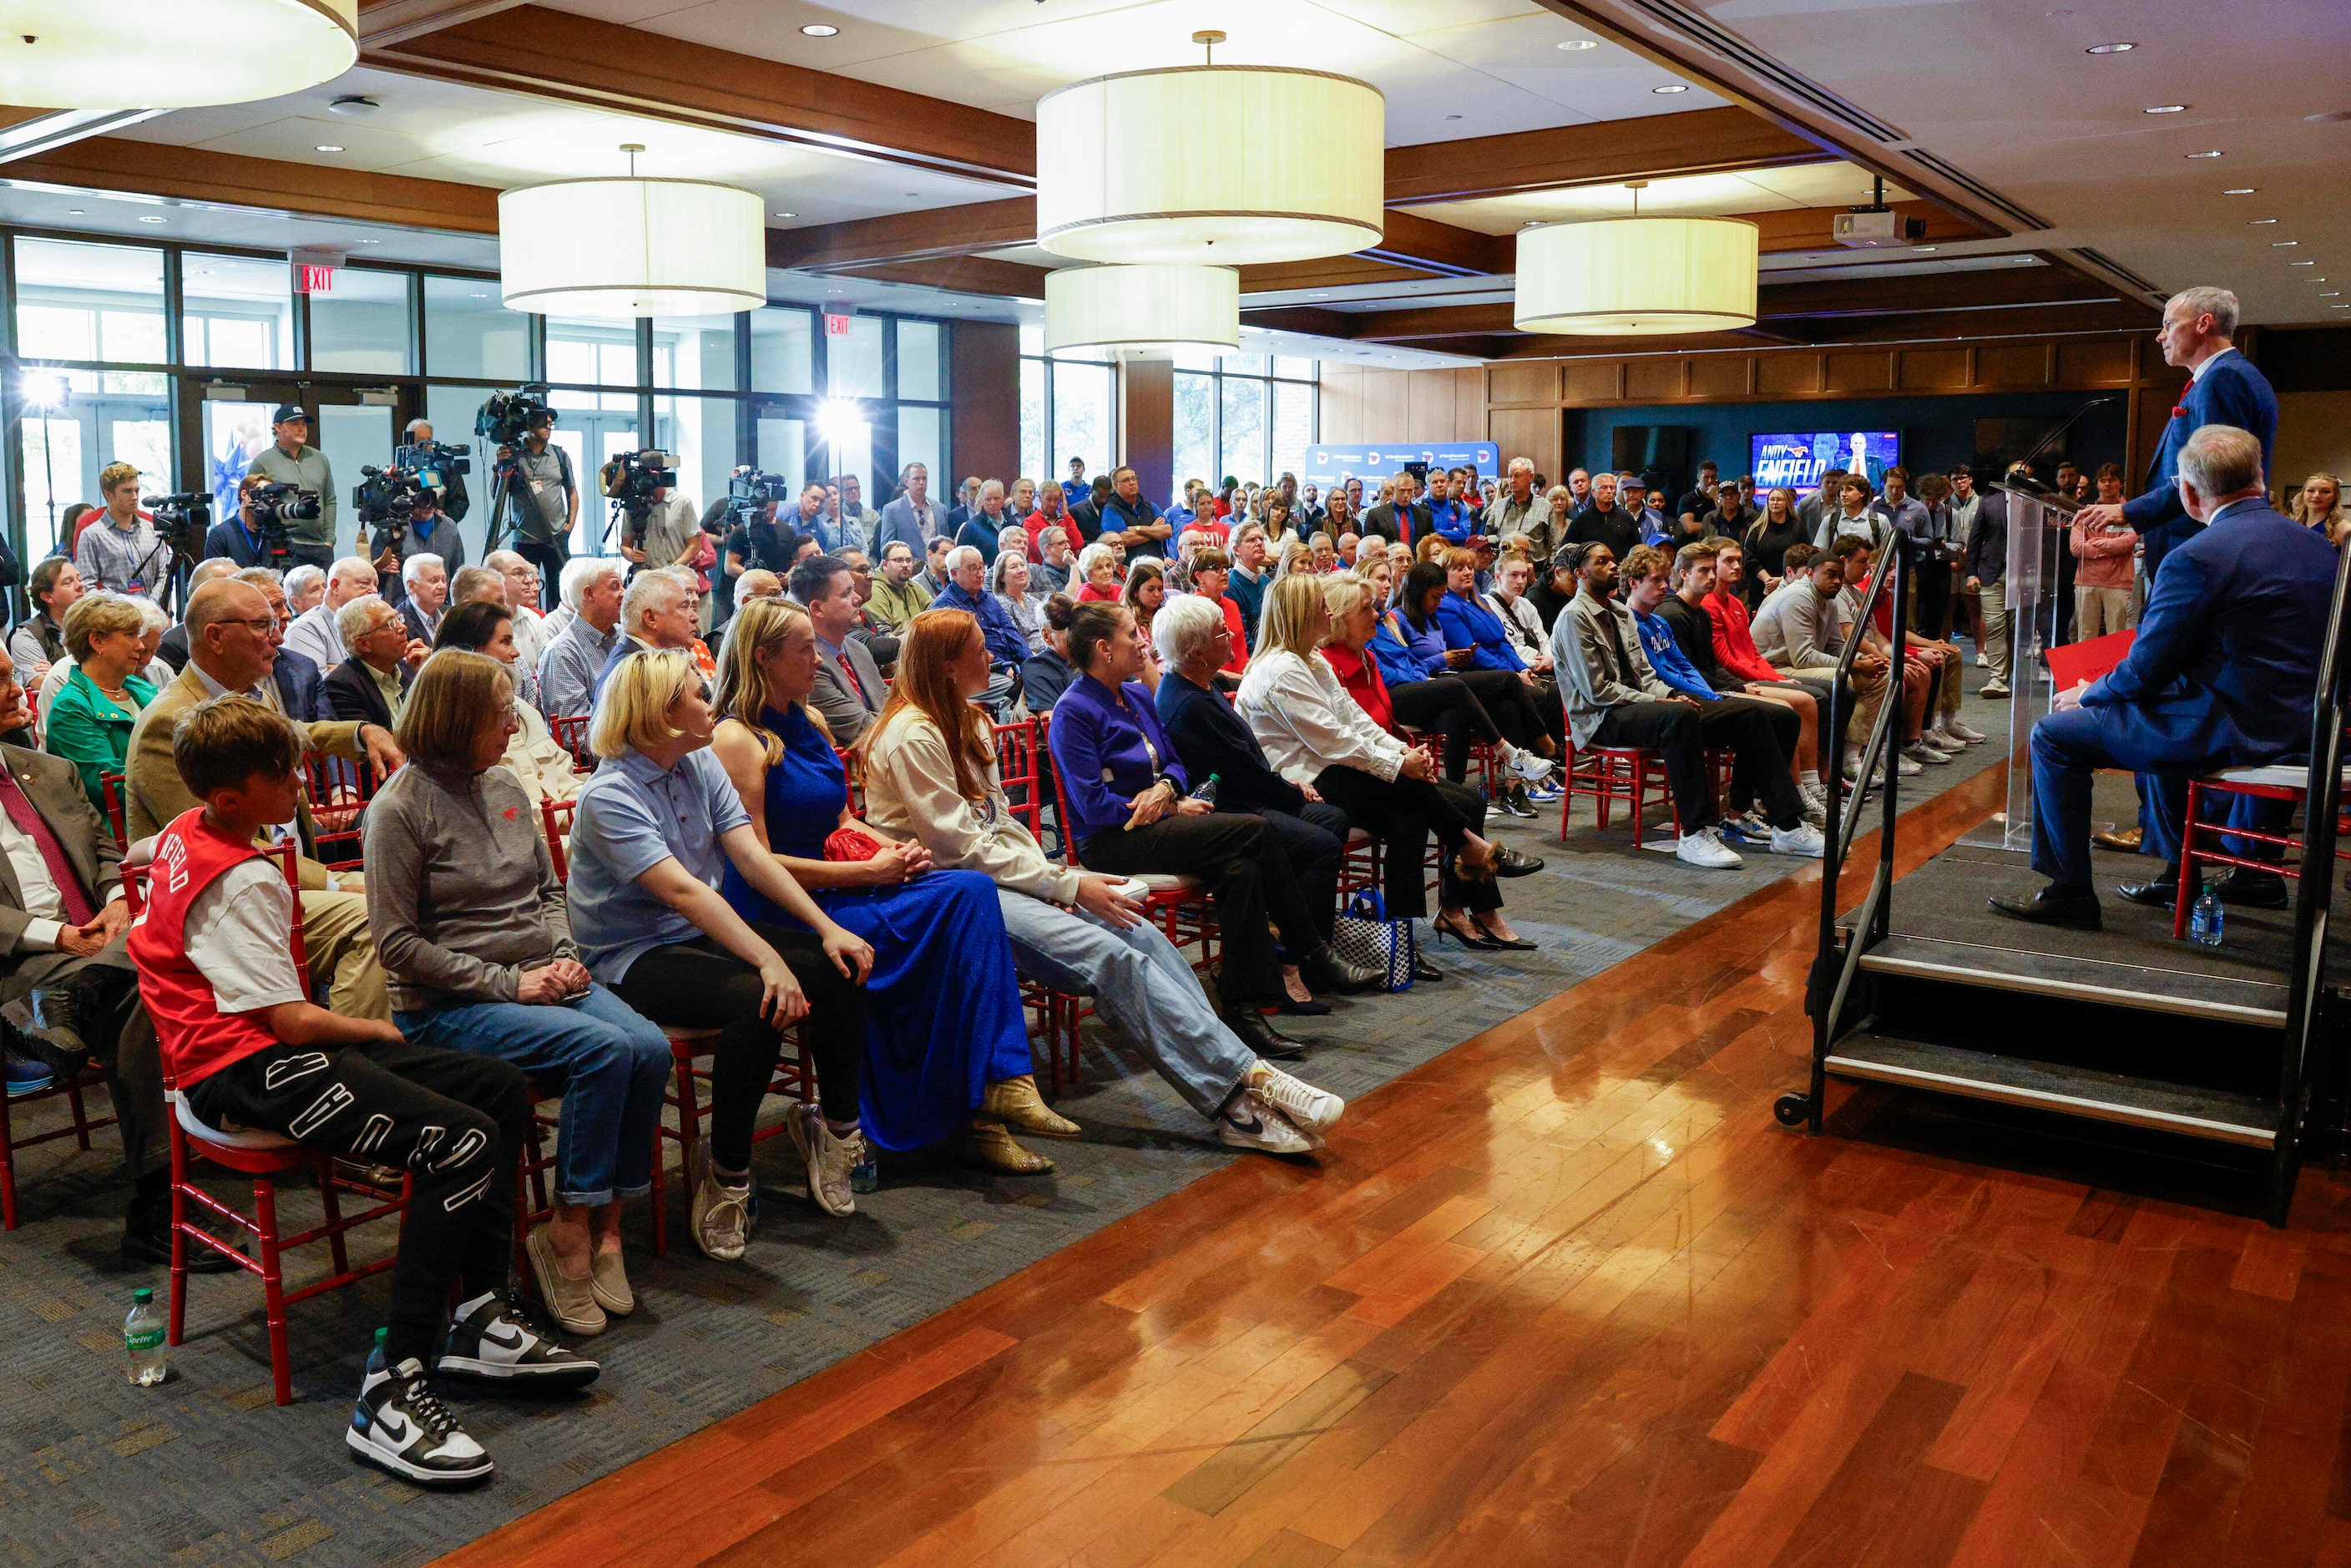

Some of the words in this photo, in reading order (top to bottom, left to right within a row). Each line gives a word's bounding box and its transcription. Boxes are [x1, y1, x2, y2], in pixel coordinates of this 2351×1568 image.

[302, 266, 334, 291] EXIT
[831, 316, 849, 335] EXIT
[1761, 444, 1788, 460] ANDY
[1755, 458, 1827, 487] ENFIELD
[1203, 533, 1224, 549] MU
[158, 832, 190, 894] NFIELD
[129, 1335, 152, 1344] Sprite
